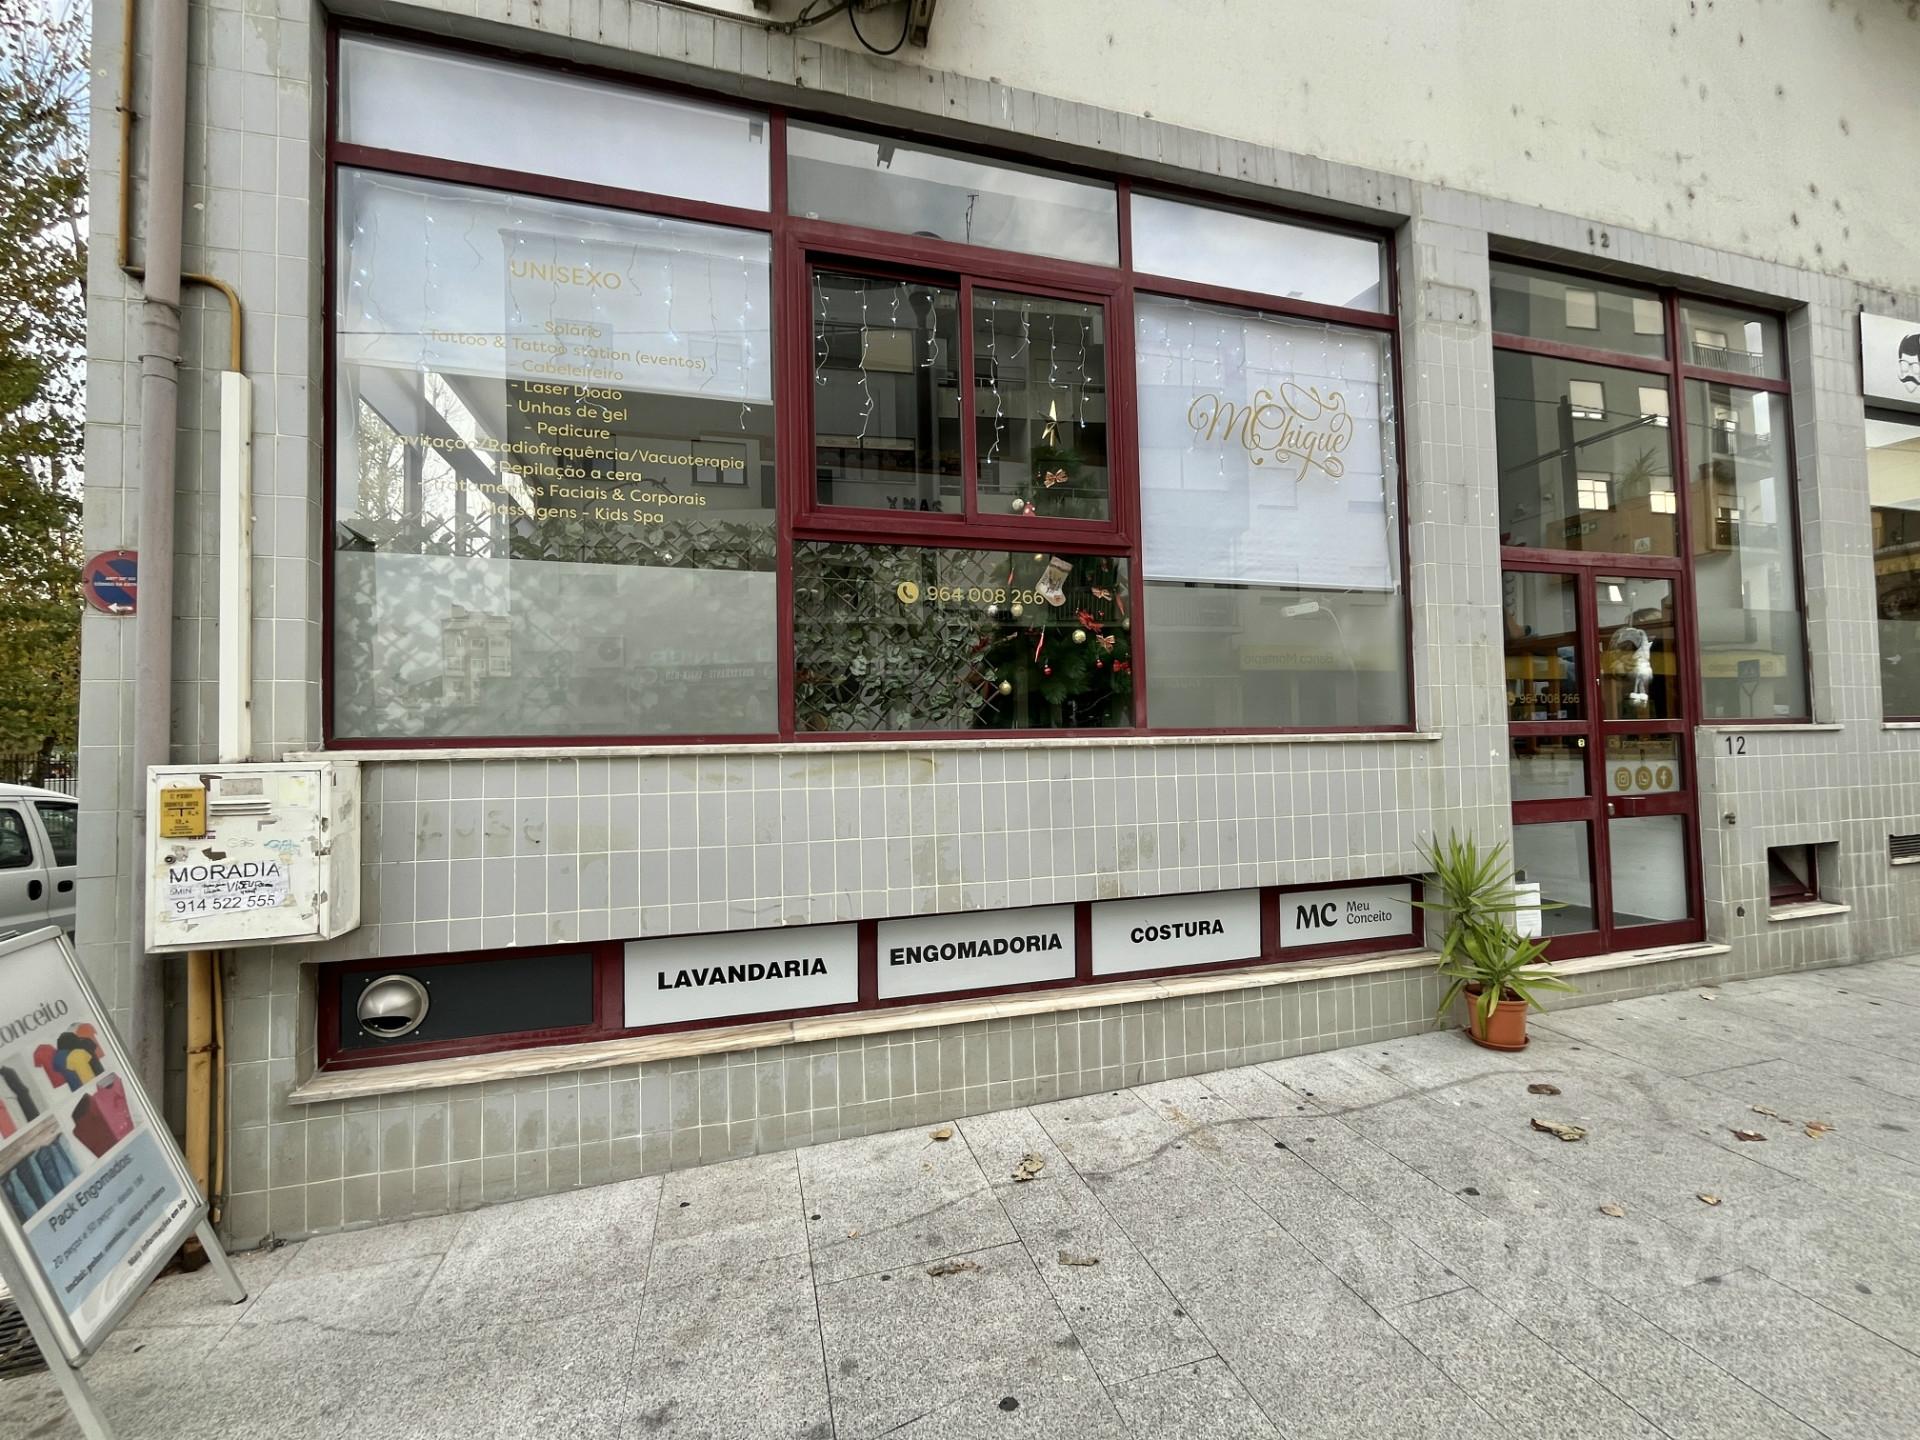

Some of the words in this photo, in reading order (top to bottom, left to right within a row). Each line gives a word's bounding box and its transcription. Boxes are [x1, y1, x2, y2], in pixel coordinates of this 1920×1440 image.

[511, 259, 622, 290] UNISEXO
[544, 320, 602, 339] Solário
[430, 329, 487, 347] Tattoo
[511, 337, 567, 355] Tattoo
[574, 344, 631, 361] station
[635, 350, 706, 372] (eventos)
[521, 359, 624, 381] Cabeleireiro
[524, 379, 569, 396] Laser
[574, 383, 623, 401] Diodo
[518, 399, 572, 417] Unhas
[576, 404, 598, 419] de
[602, 408, 628, 423] gel
[537, 421, 610, 440] Pedicure
[500, 460, 586, 480] Depilação
[590, 469, 601, 479] a
[606, 470, 642, 482] cera
[550, 484, 608, 500] Faciais
[612, 488, 626, 501] &
[630, 489, 707, 507] Corporais
[481, 501, 577, 521] Massagens
[595, 507, 629, 521] Kids
[633, 508, 664, 525] Spa
[927, 585, 963, 602] 964
[968, 587, 1006, 604] 008
[1011, 588, 1044, 605] 266
[1519, 693, 1537, 704] 964
[1540, 693, 1560, 704] 008
[1562, 693, 1580, 704] 266
[1725, 735, 1747, 756] 12
[169, 863, 280, 884] MORADIA
[176, 899, 206, 914] 914
[212, 896, 242, 910] 522
[246, 894, 276, 907] 555
[1346, 900, 1370, 913] Meu
[1296, 902, 1338, 930] MC
[1346, 910, 1393, 925] Conceito
[1130, 919, 1225, 944] COSTURA
[890, 932, 1063, 966] ENGOMADORIA
[657, 957, 828, 990] LAVANDARIA
[48, 1201, 79, 1233] Pack
